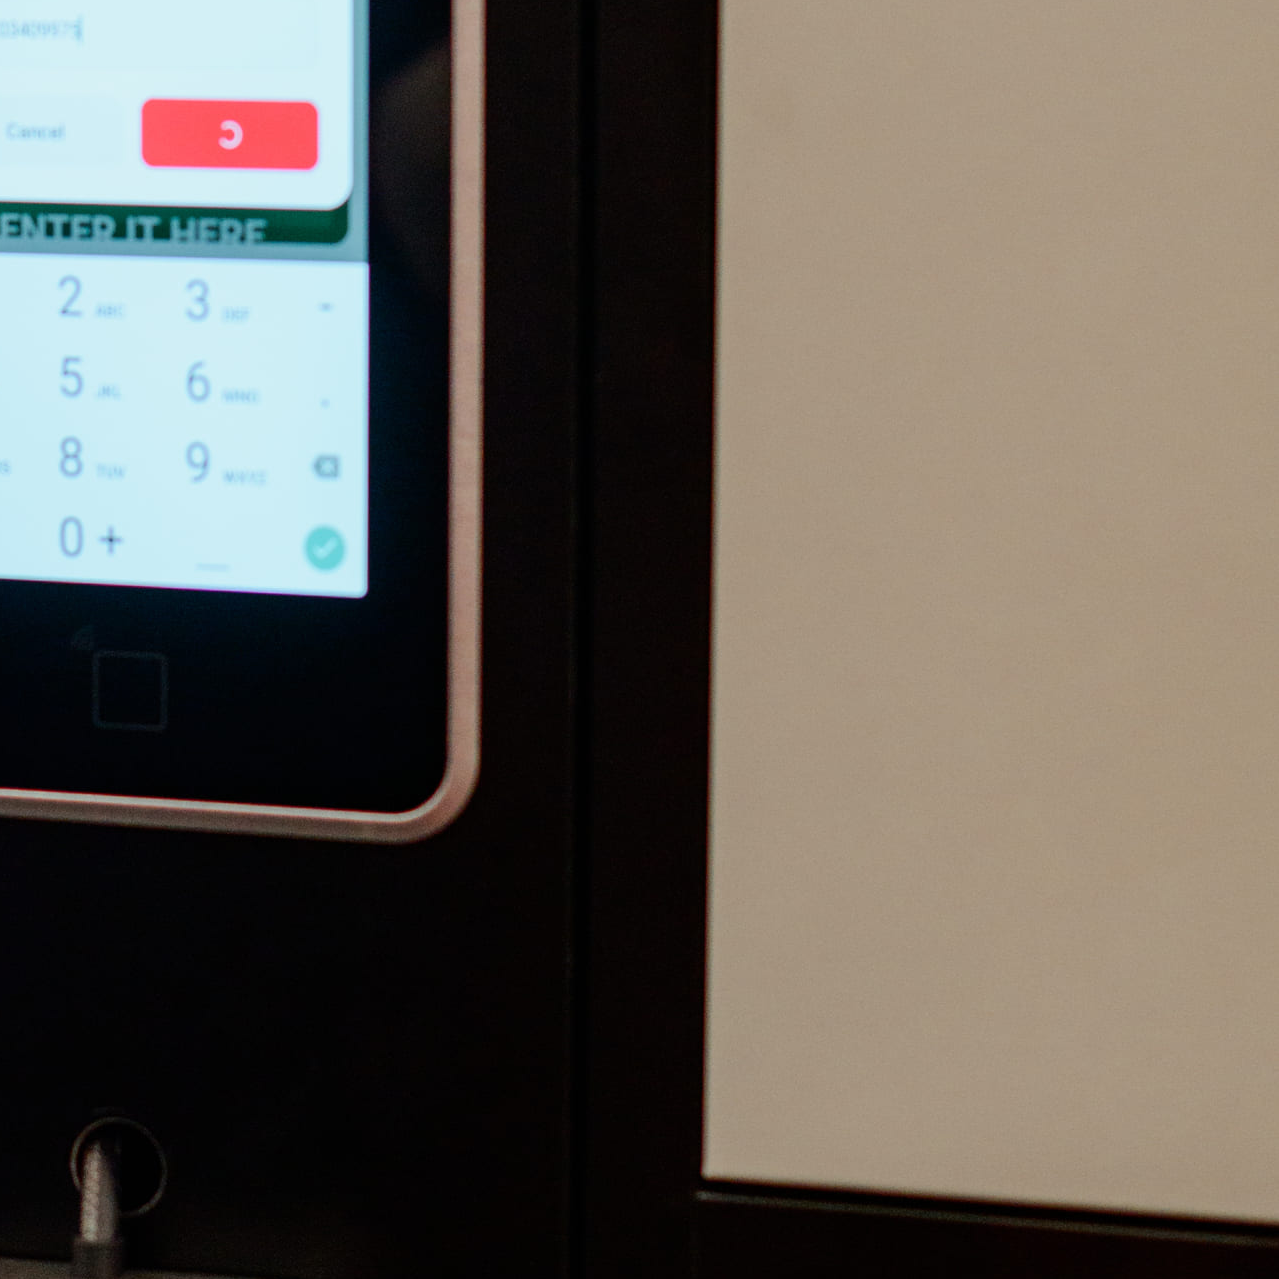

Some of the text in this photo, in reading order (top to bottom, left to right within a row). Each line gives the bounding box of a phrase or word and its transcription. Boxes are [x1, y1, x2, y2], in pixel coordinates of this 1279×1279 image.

[6, 122, 66, 141] Cancel
[126, 217, 162, 242] IT
[171, 219, 269, 245] HERE
[59, 276, 83, 318] 2
[186, 279, 210, 322] 3
[60, 357, 84, 398] 5
[186, 361, 211, 403] 6
[59, 437, 83, 479] 8
[186, 441, 211, 484] 9
[59, 516, 84, 558] 0
